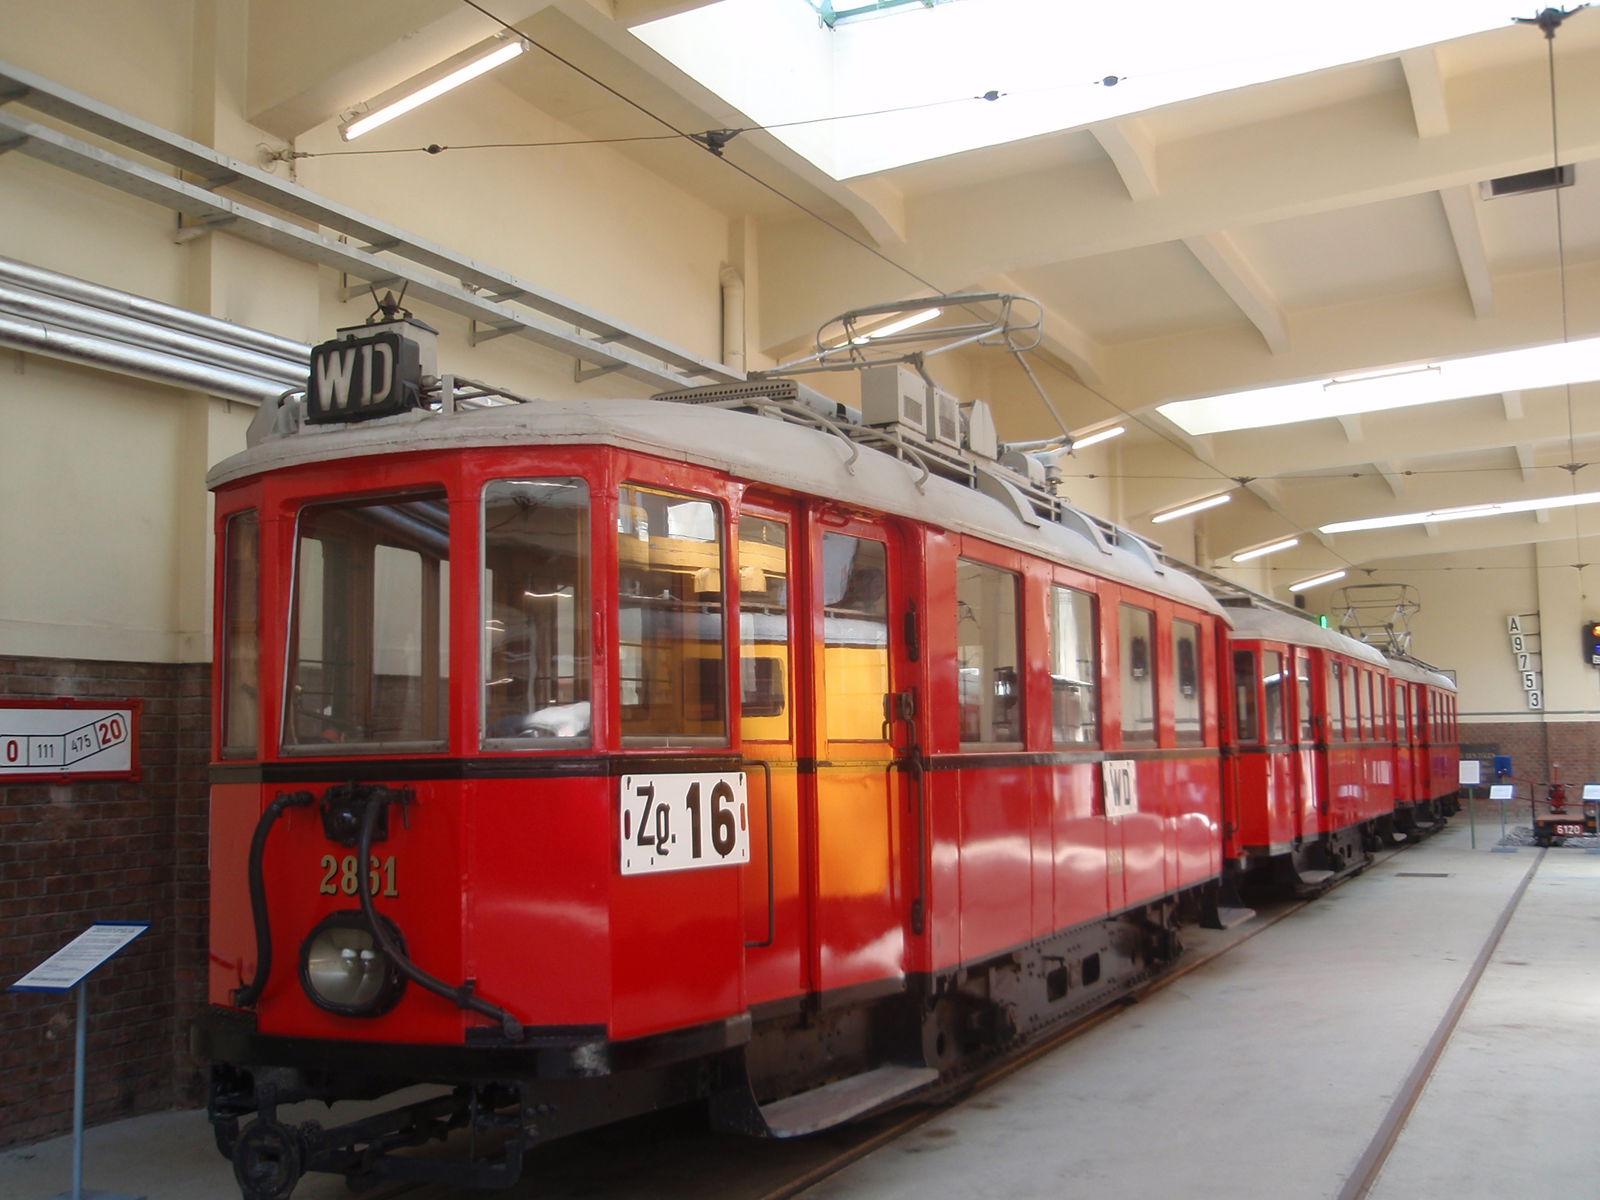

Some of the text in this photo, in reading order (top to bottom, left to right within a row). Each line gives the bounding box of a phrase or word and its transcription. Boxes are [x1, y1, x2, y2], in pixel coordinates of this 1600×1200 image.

[316, 342, 393, 412] WD
[1509, 617, 1519, 632] A
[1513, 636, 1522, 651] 9
[1519, 654, 1527, 669] 7
[1525, 673, 1533, 689] 5
[1531, 692, 1539, 707] 3
[37, 743, 54, 758] 111
[71, 734, 91, 753] 475
[99, 719, 122, 745] 20
[686, 779, 736, 859] 16
